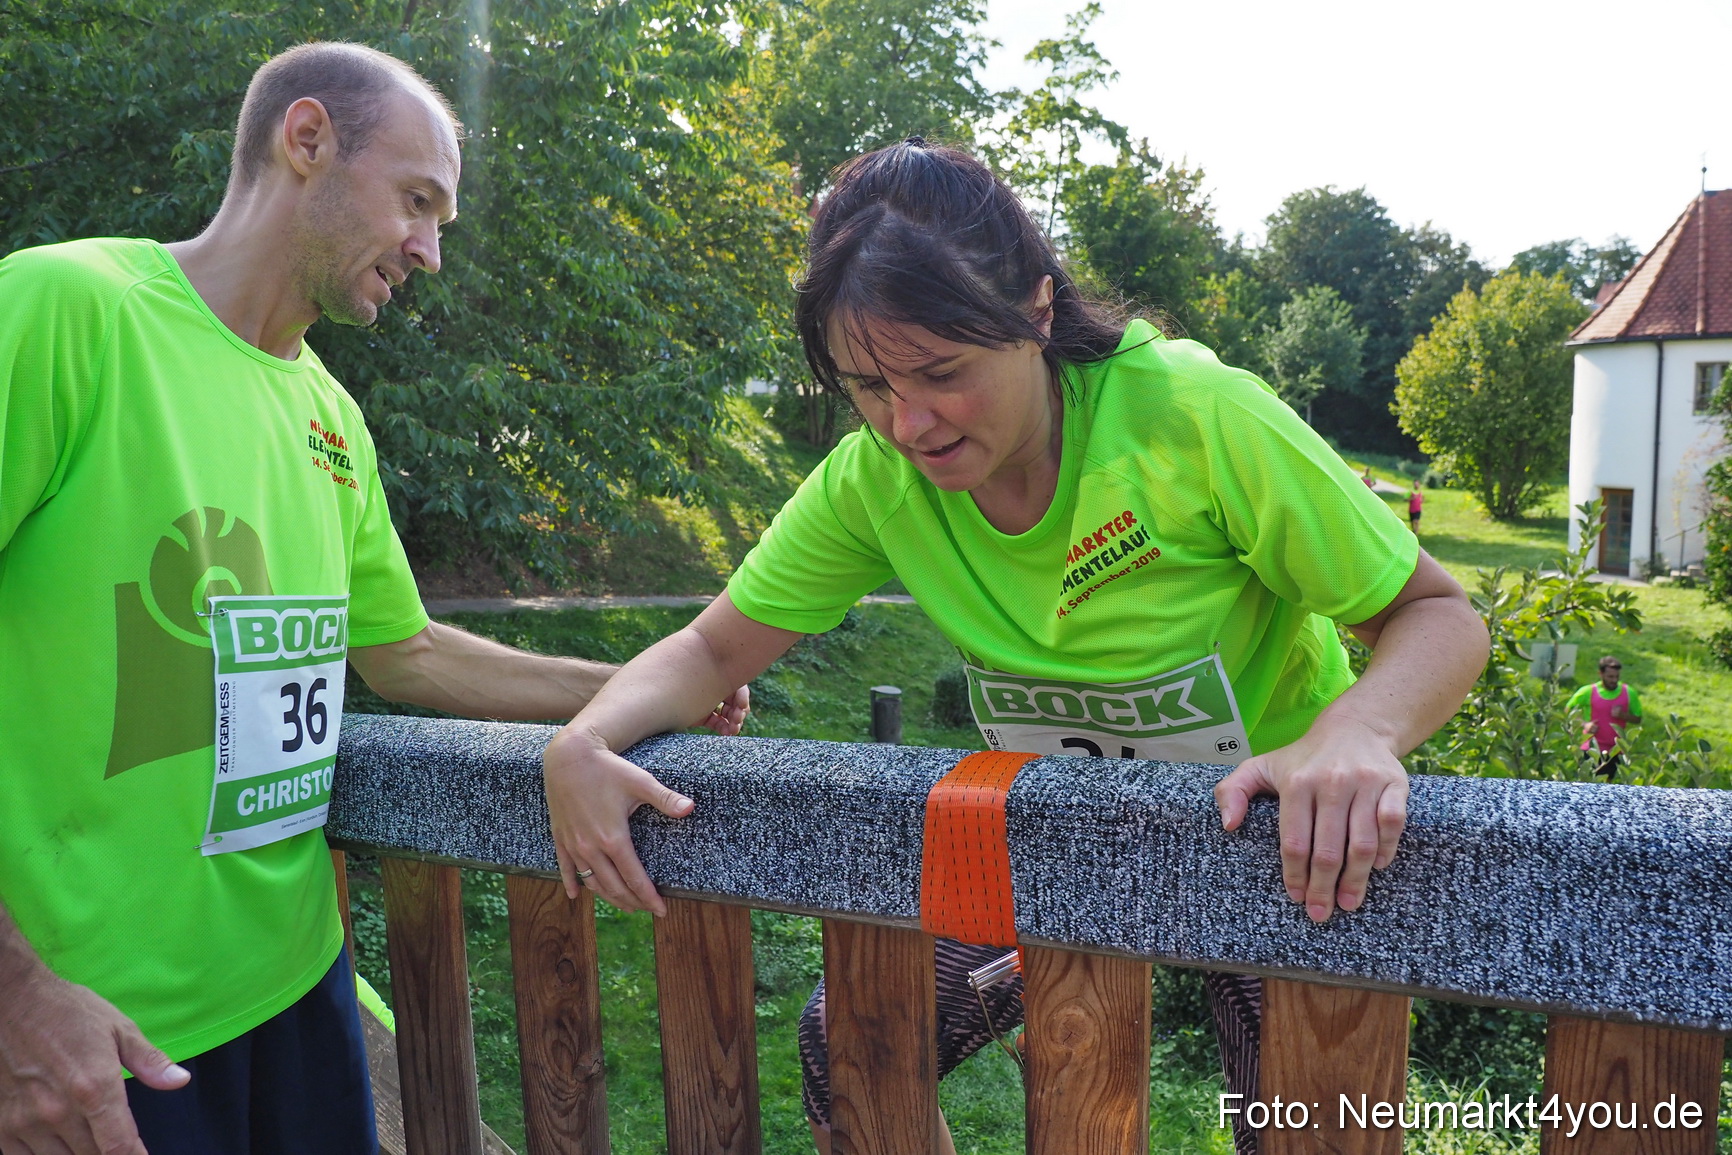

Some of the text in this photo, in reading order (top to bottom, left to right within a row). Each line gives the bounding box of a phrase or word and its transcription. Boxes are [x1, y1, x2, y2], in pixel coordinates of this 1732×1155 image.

[1060, 524, 1151, 596] MENTELAUF
[1067, 566, 1132, 609] September
[1131, 547, 1161, 570] 2019
[280, 677, 328, 753] 36
[984, 684, 1201, 728] BOCK
[1217, 740, 1238, 752] E6
[237, 764, 335, 816] CHRISTO
